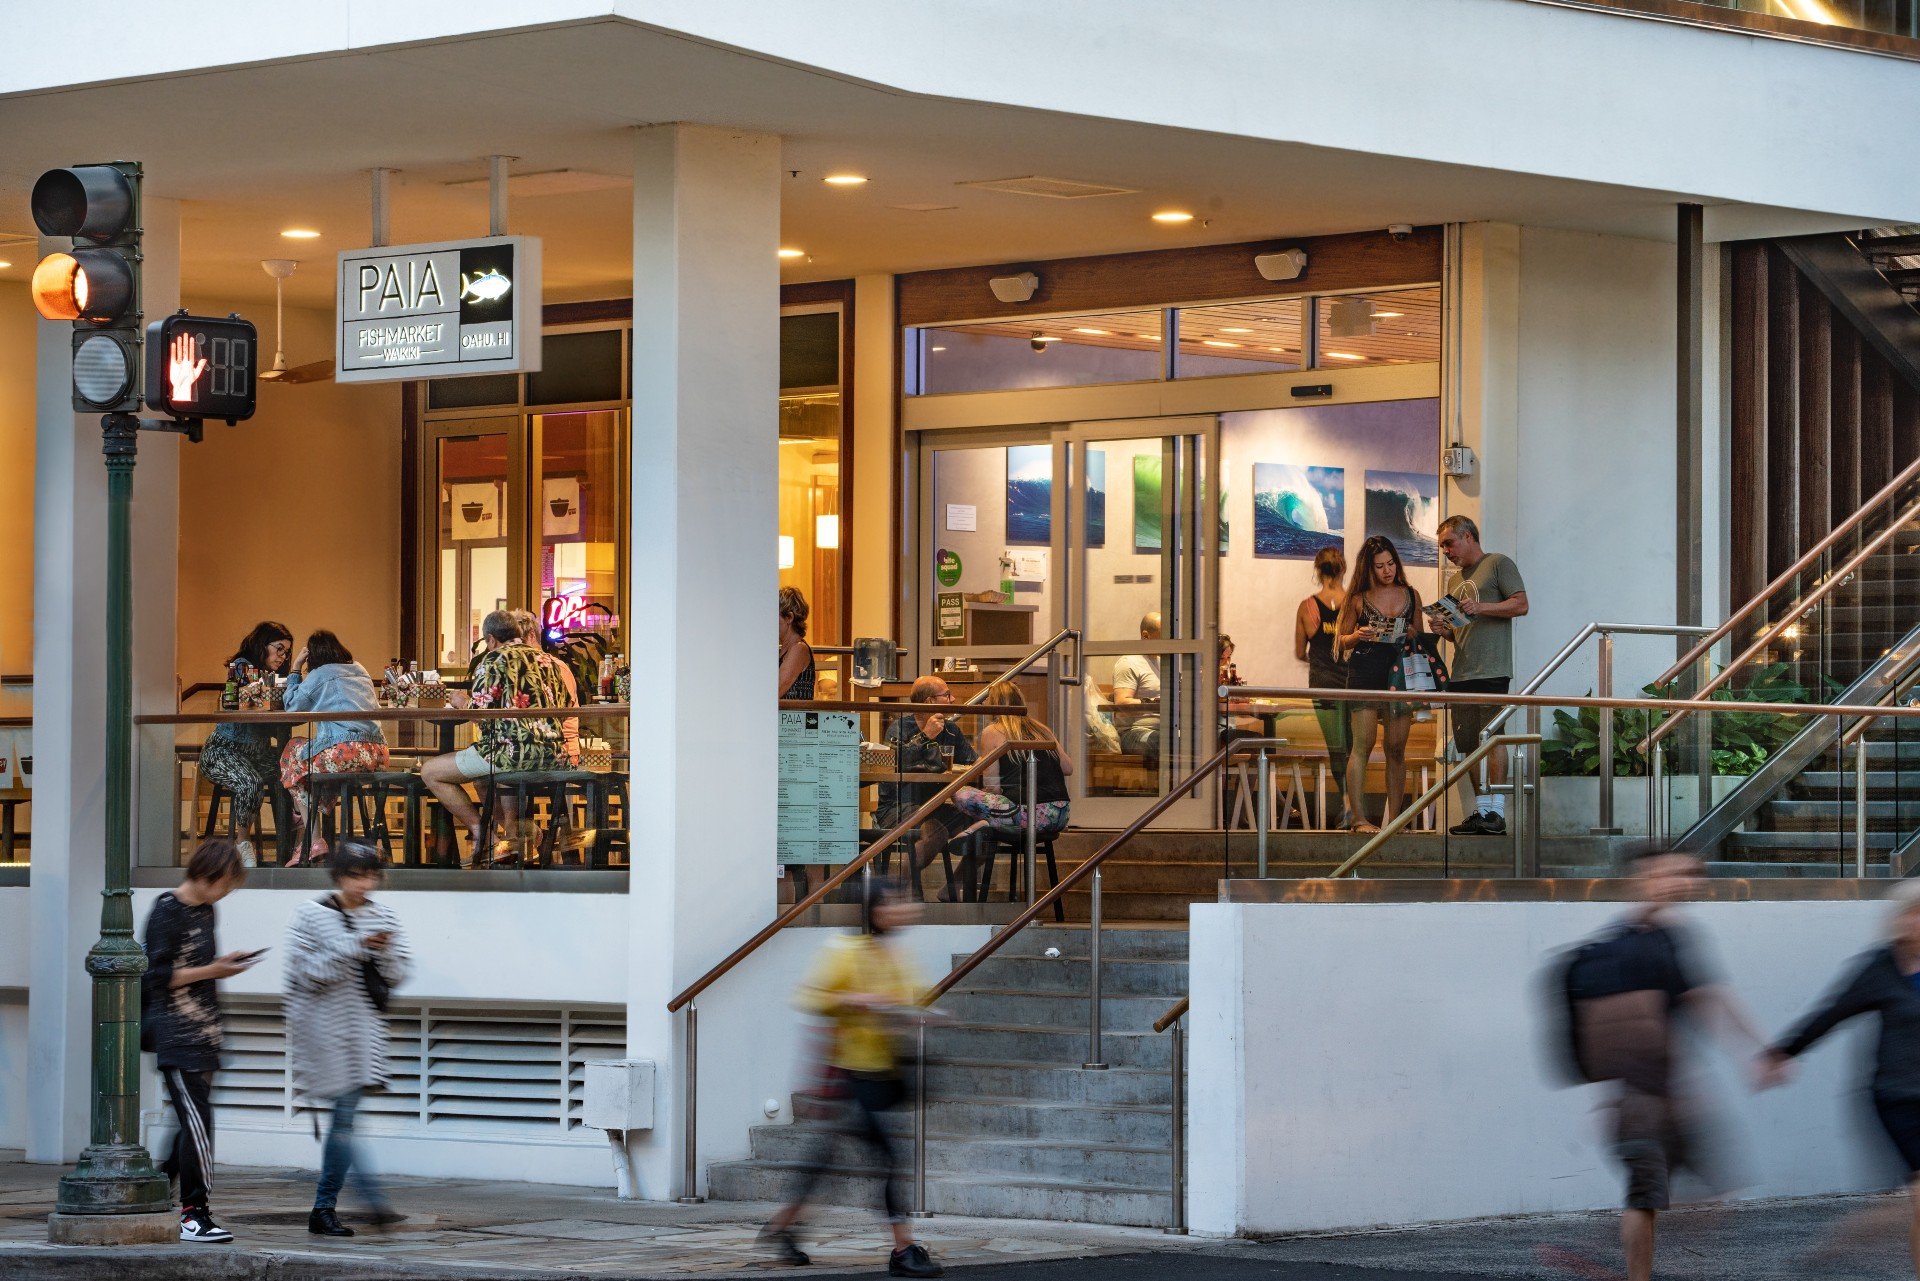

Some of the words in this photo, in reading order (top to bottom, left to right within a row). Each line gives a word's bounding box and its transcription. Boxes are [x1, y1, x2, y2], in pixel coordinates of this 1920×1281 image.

[359, 259, 445, 313] PAIA
[358, 323, 444, 347] FISHMARKET
[497, 331, 510, 346] HI
[941, 563, 958, 571] squad
[942, 598, 960, 606] PASS
[781, 713, 803, 725] PAIA
